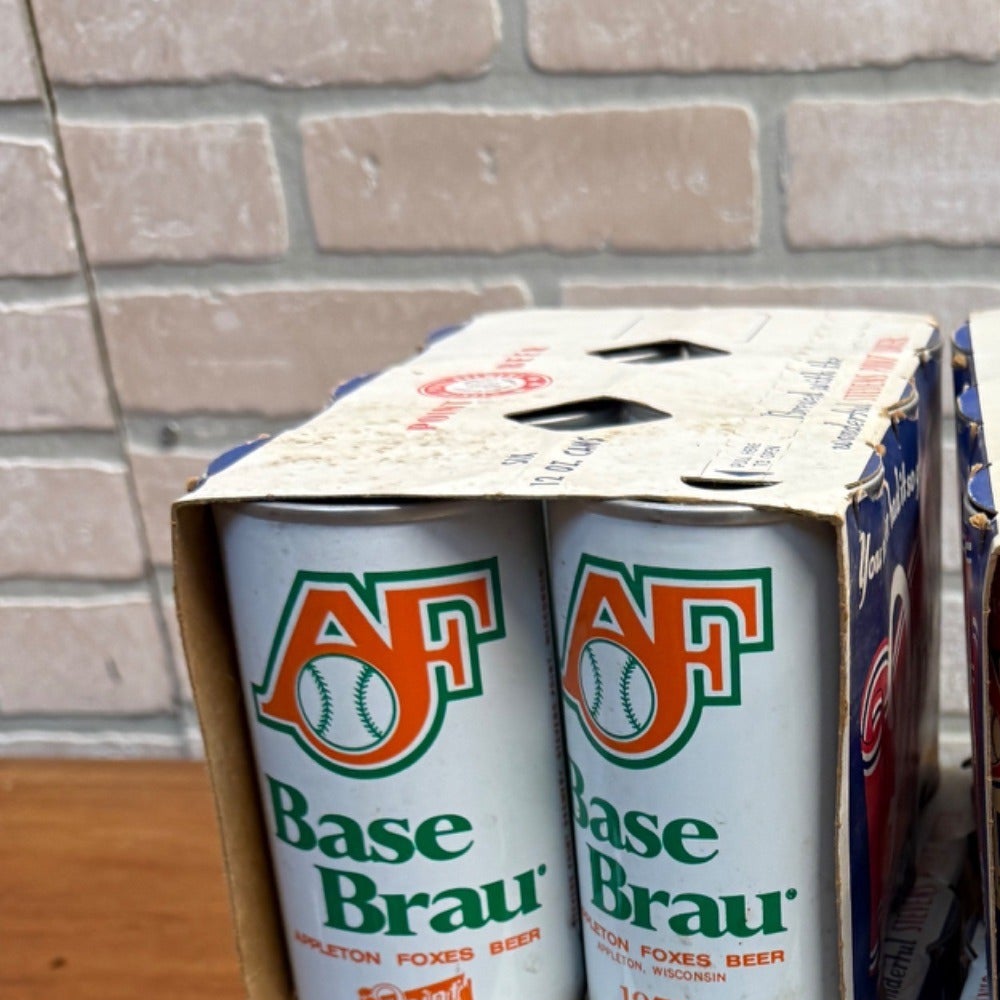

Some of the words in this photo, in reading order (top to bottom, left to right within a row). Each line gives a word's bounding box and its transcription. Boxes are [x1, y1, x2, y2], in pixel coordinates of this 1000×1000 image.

[530, 476, 564, 486] 12
[264, 773, 474, 865] Base
[295, 929, 381, 964] APPLETON
[397, 947, 475, 967] FOXES
[489, 928, 541, 956] BEER
[641, 945, 712, 968] FOXES
[726, 949, 785, 968] BEER
[652, 965, 727, 983] WISCONSIN
